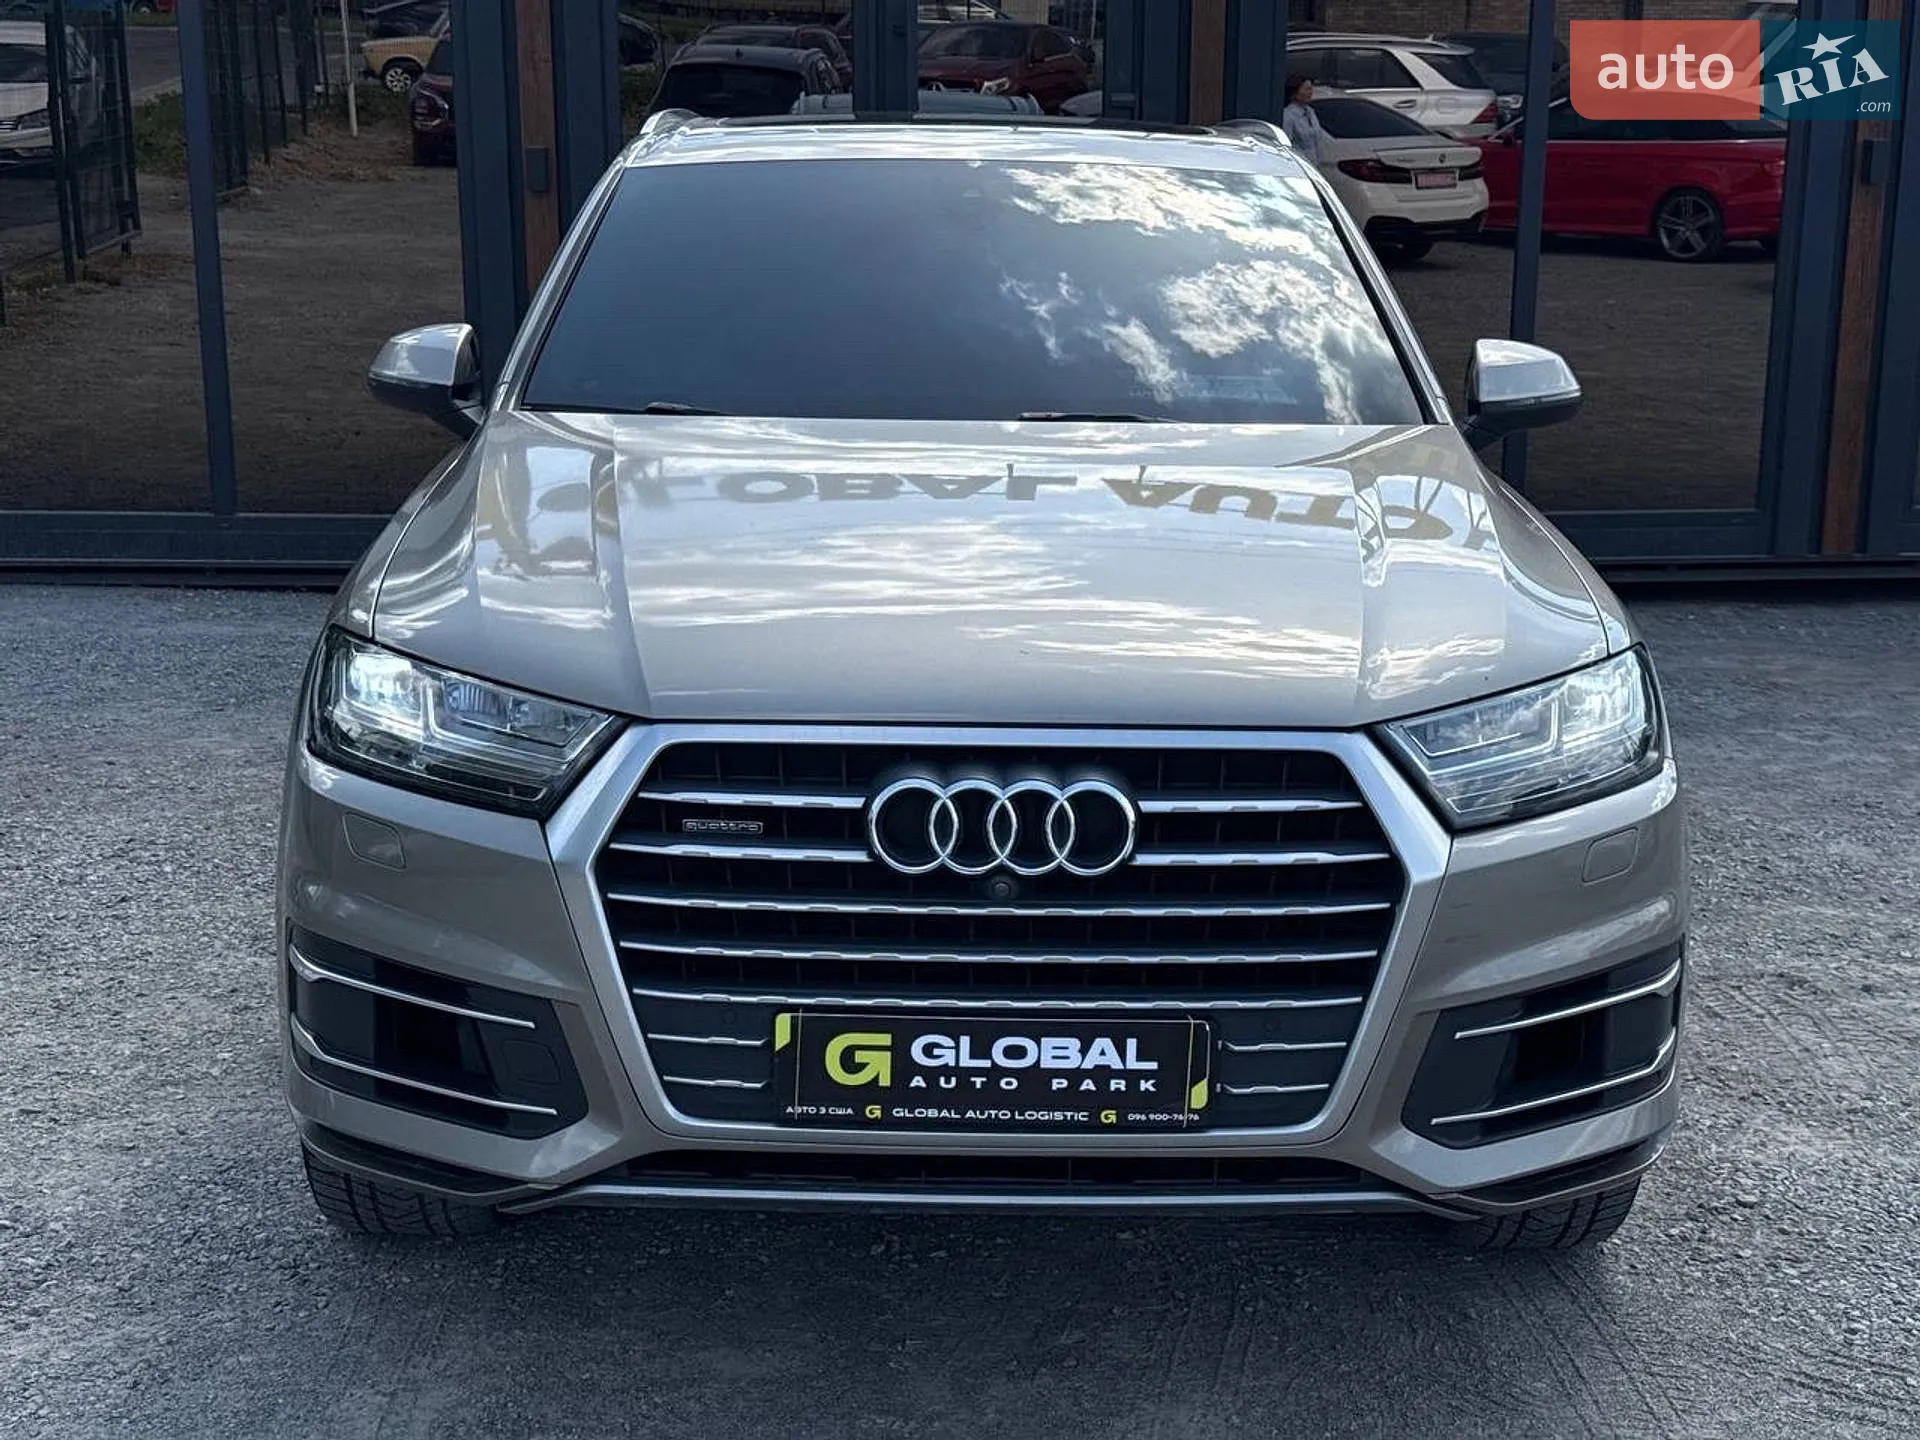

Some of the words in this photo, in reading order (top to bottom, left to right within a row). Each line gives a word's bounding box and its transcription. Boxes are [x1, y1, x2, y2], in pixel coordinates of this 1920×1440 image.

[685, 820, 760, 832] quattro
[910, 1034, 1159, 1070] GLOBAL
[908, 1076, 1018, 1090] AUTO
[1052, 1078, 1157, 1092] PARK
[892, 1108, 961, 1118] GLOBAL
[964, 1110, 1011, 1119] AUTO
[1015, 1110, 1089, 1121] LOGISTIC
